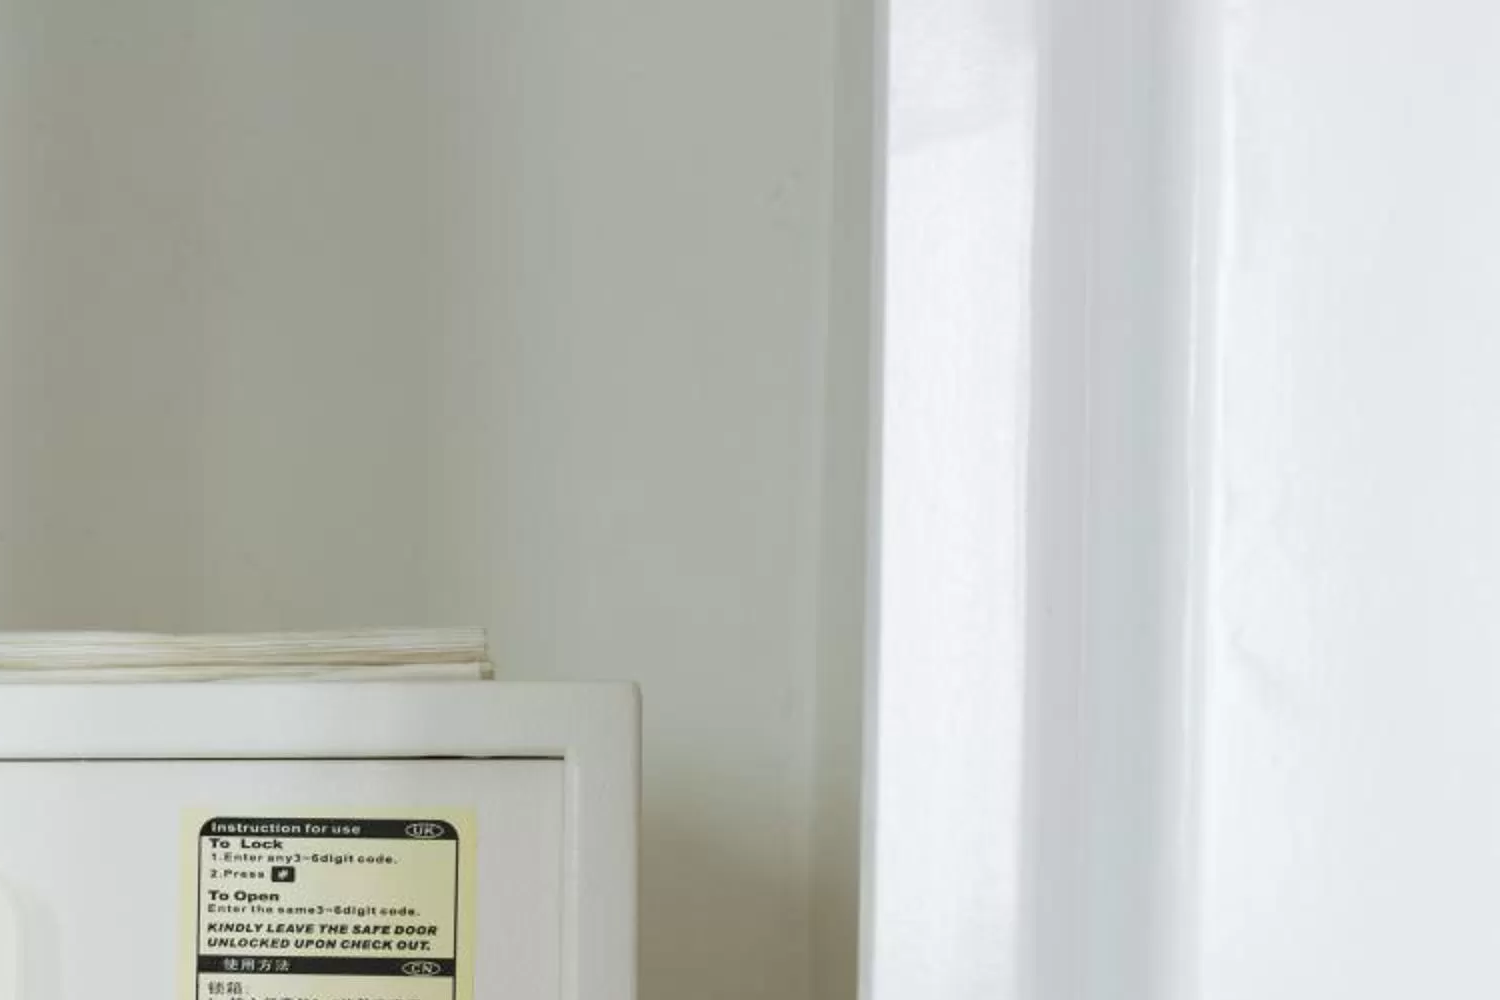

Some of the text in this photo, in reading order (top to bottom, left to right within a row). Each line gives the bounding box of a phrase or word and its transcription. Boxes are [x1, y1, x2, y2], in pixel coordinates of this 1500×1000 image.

[305, 823, 328, 835] for
[332, 826, 361, 836] use
[209, 837, 285, 849] To Lock
[207, 890, 280, 903] To Open
[250, 905, 274, 914] the
[207, 923, 438, 936] KINDLY LEAVE THE SAFE DOOR
[207, 938, 431, 951] UNLOCKED UPON CHECK OUT.
[223, 957, 291, 973] 使用方法
